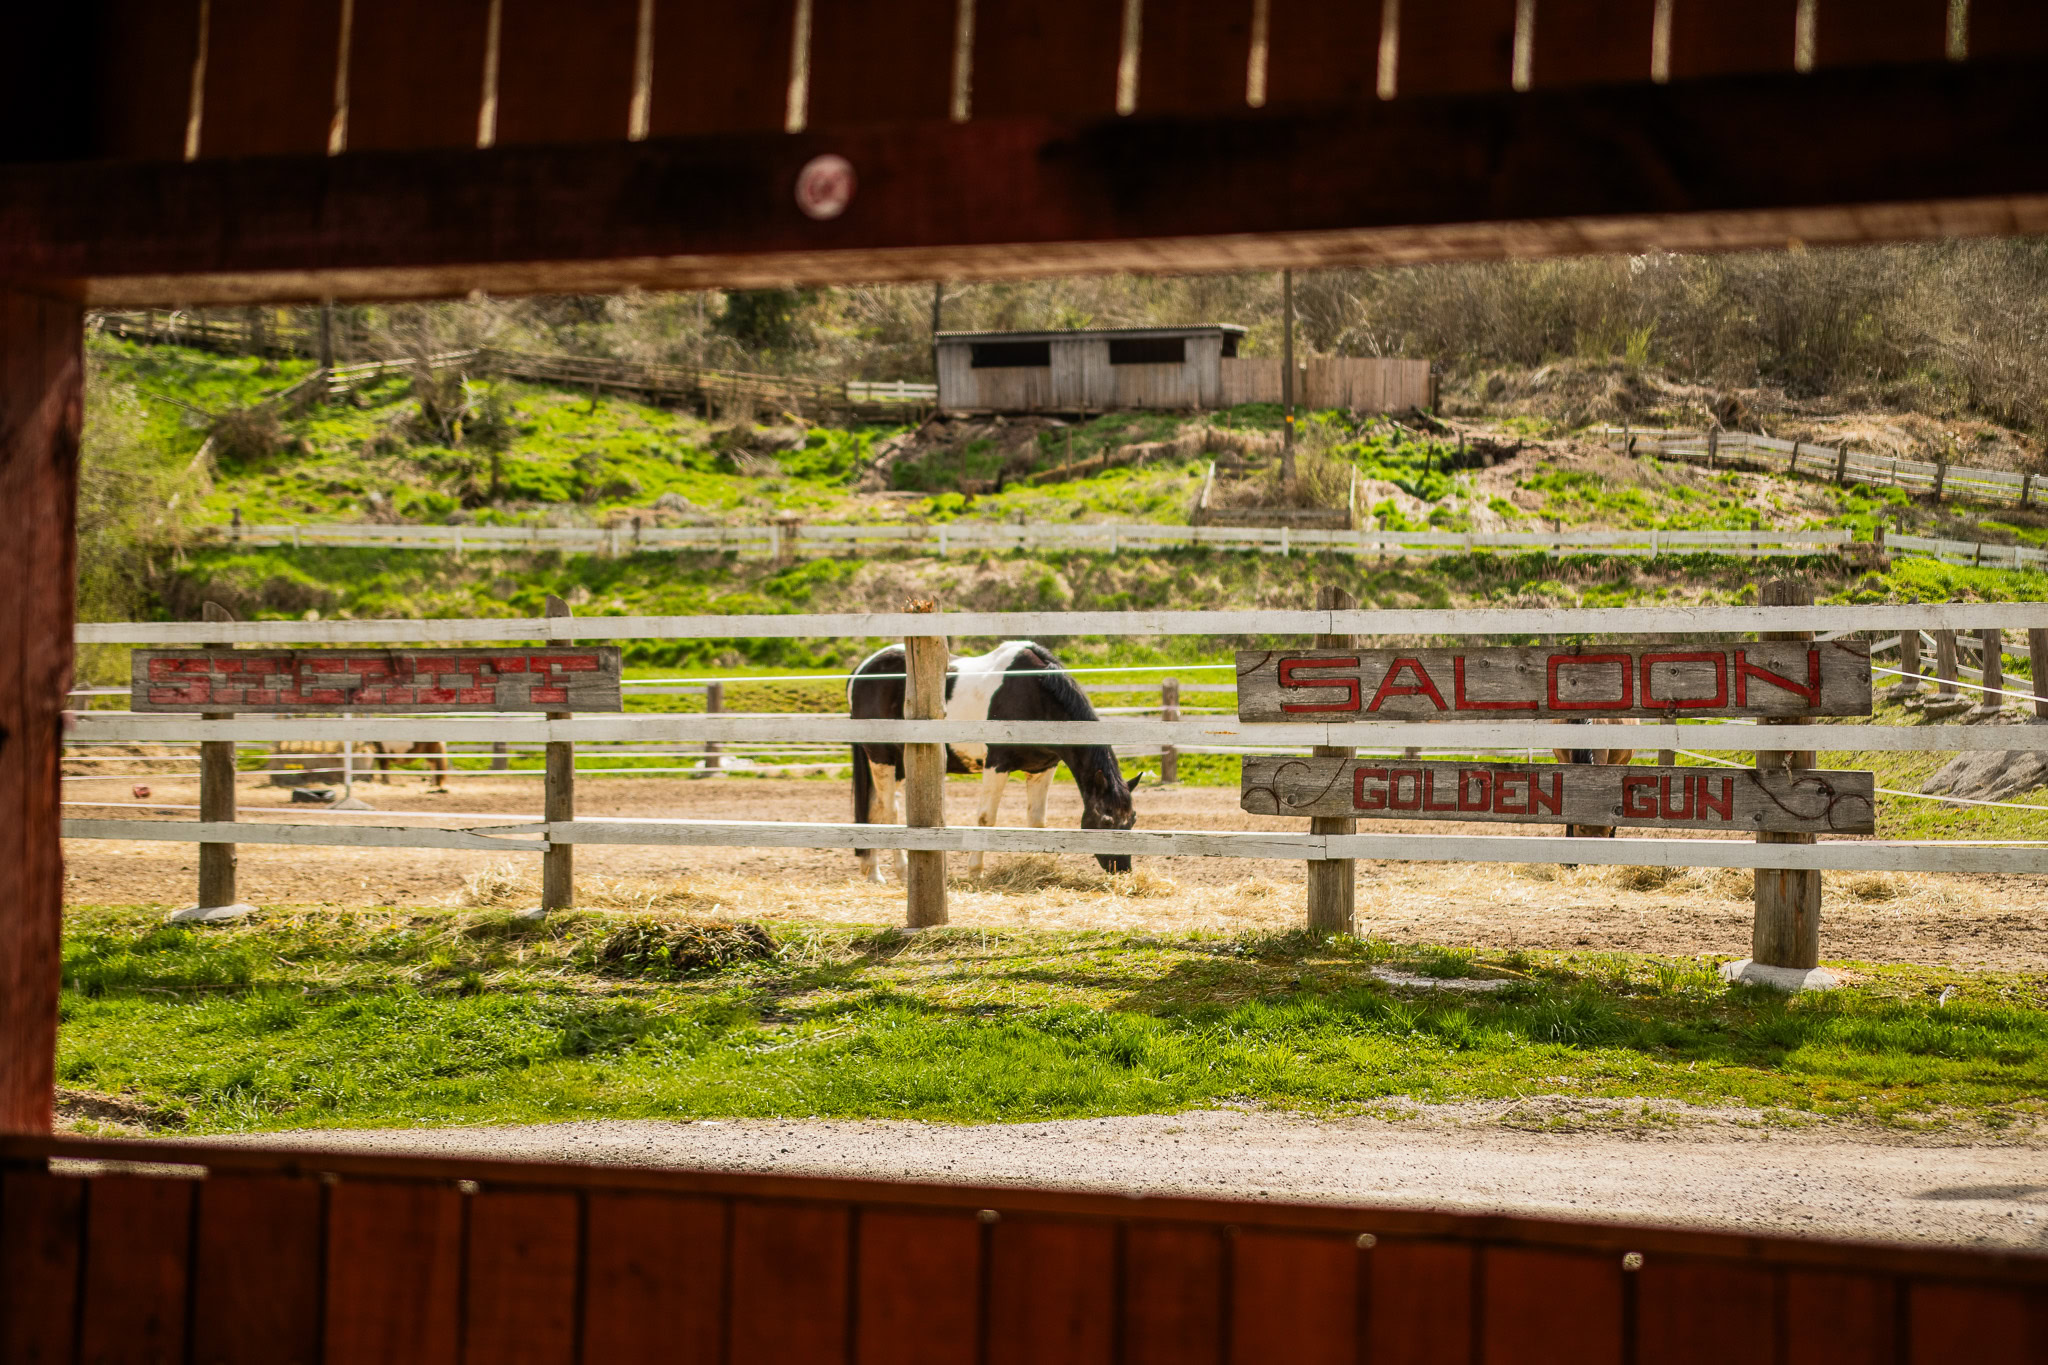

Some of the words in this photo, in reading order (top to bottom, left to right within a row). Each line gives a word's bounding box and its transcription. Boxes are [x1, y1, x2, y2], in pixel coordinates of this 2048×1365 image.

[148, 656, 600, 705] SHERIFF
[1277, 650, 1822, 714] SALOON
[1353, 767, 1563, 816] GOLDEN
[1622, 774, 1735, 822] GUN
